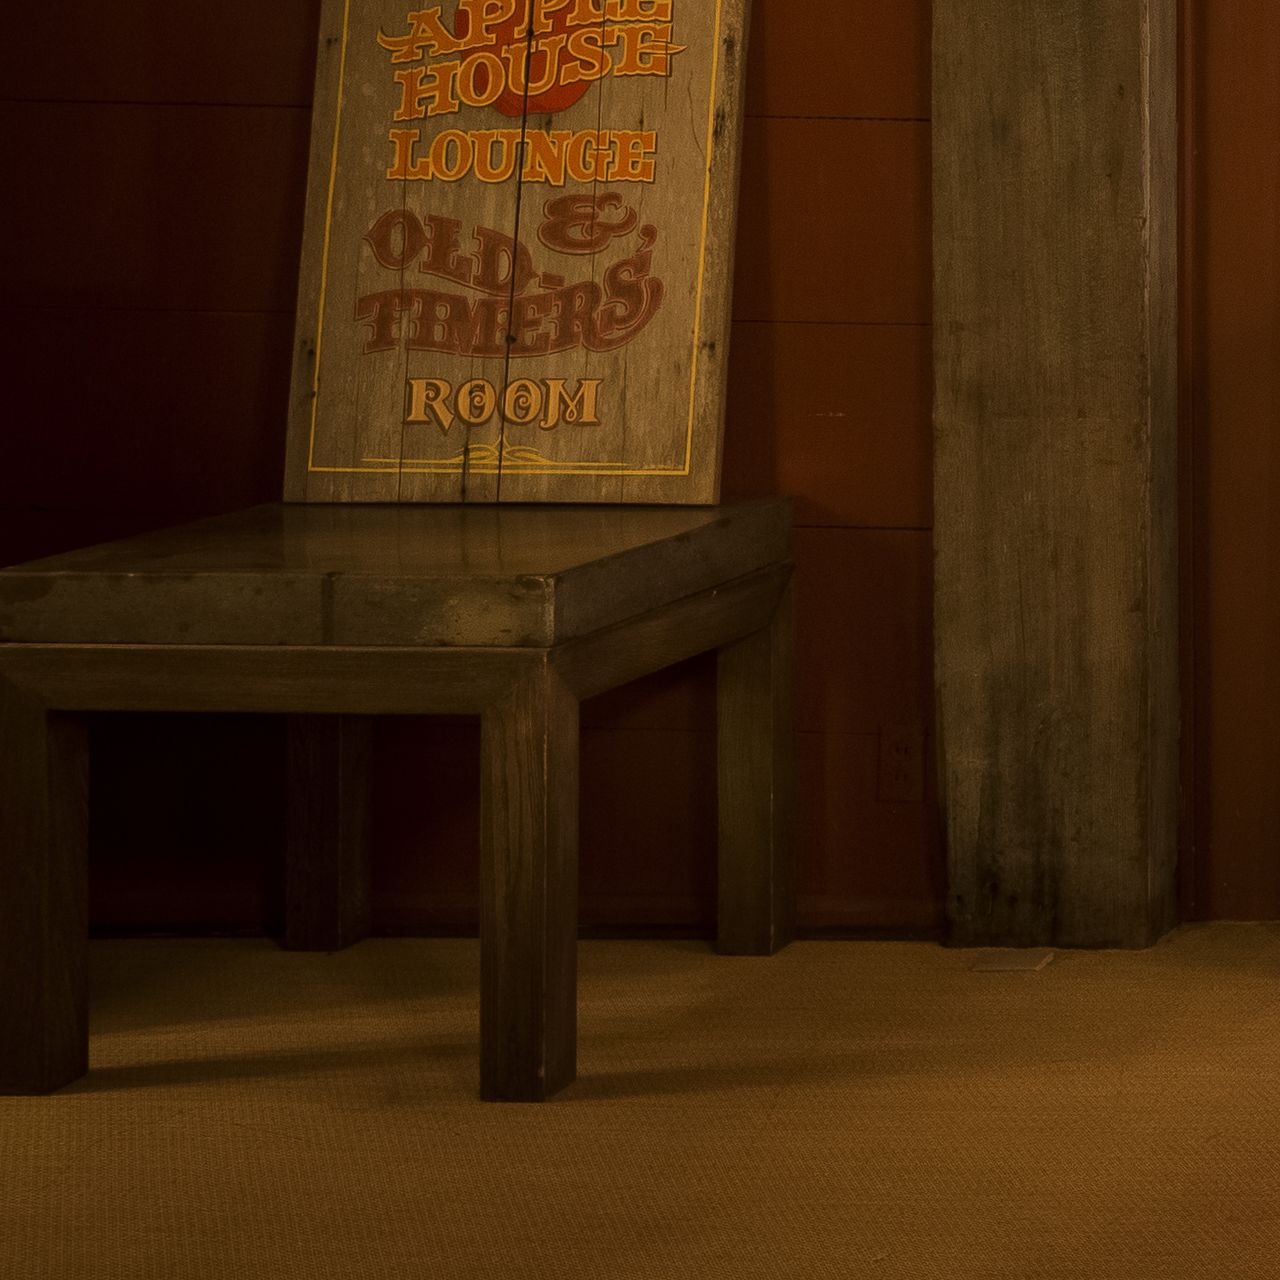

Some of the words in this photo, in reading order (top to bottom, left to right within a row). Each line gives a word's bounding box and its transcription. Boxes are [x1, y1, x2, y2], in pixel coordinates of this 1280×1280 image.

[394, 23, 688, 121] HOUSE
[386, 128, 657, 186] LOUNGE
[537, 192, 638, 256] &
[406, 377, 604, 432] ROOM
